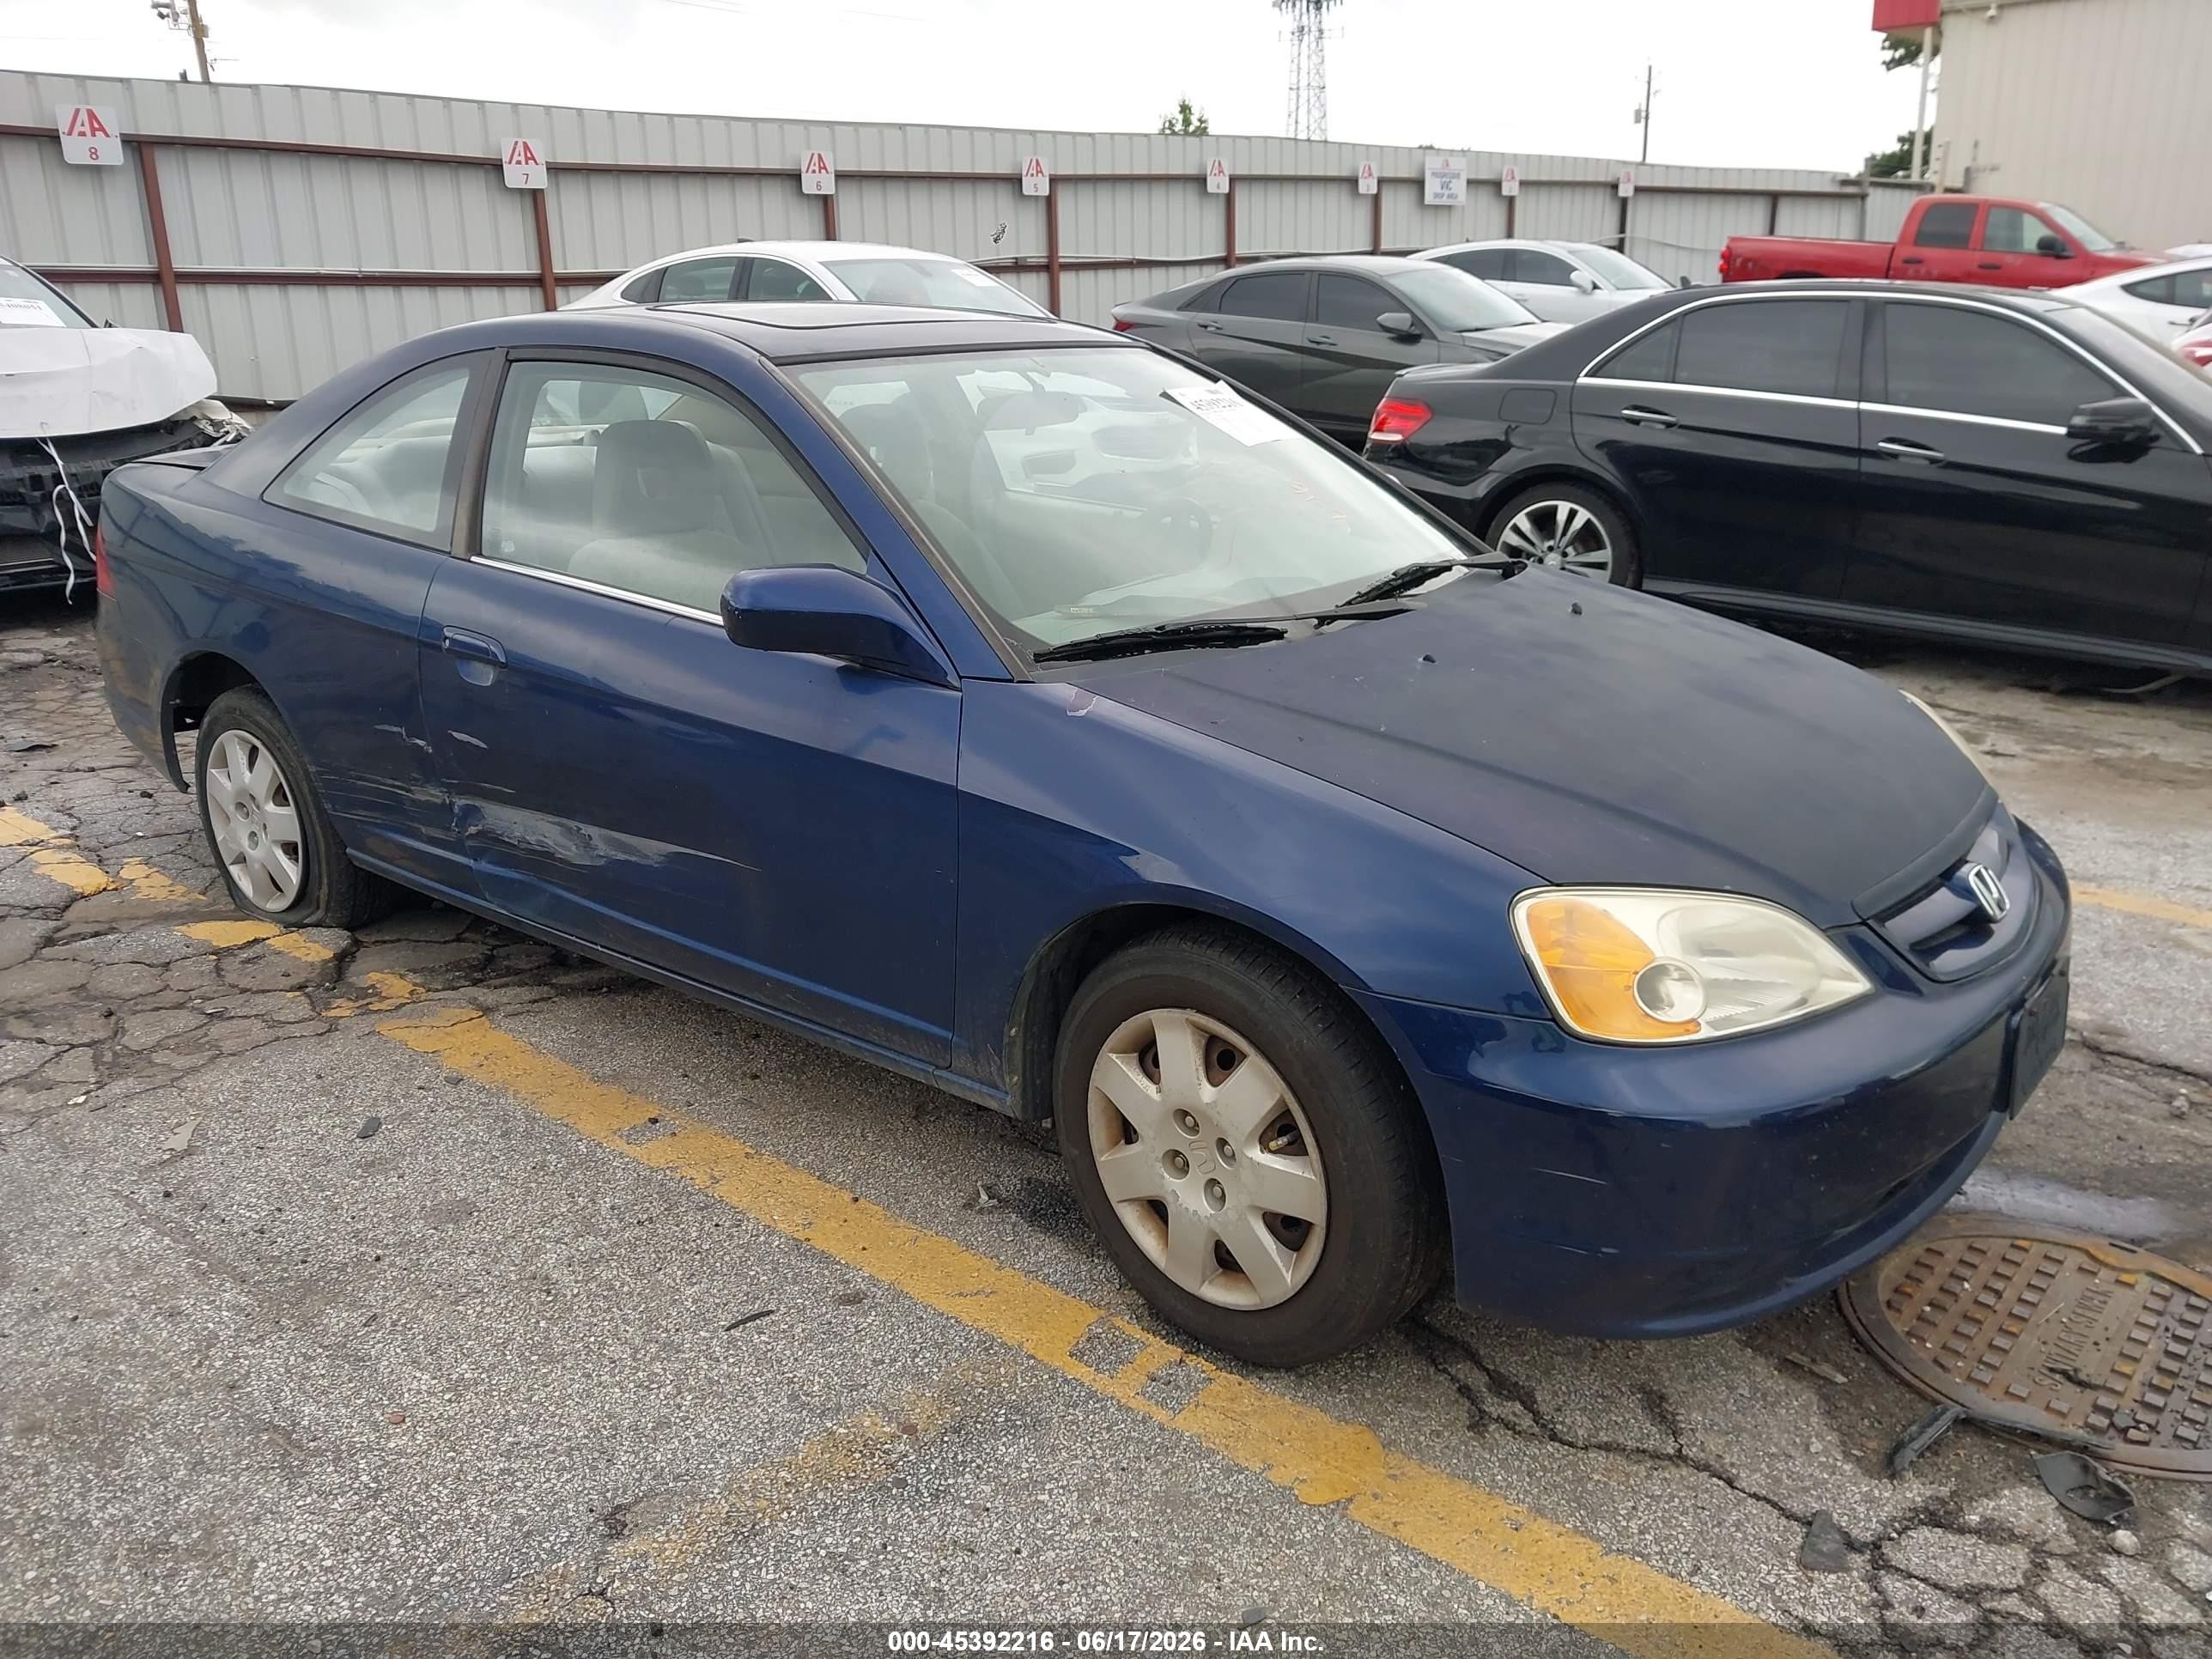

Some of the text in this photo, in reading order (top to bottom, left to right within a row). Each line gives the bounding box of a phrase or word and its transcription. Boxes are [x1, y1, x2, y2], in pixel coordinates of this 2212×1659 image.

[88, 147, 99, 161] 8
[521, 173, 529, 185] 7
[816, 180, 822, 191] 6
[1033, 183, 1038, 192] 5
